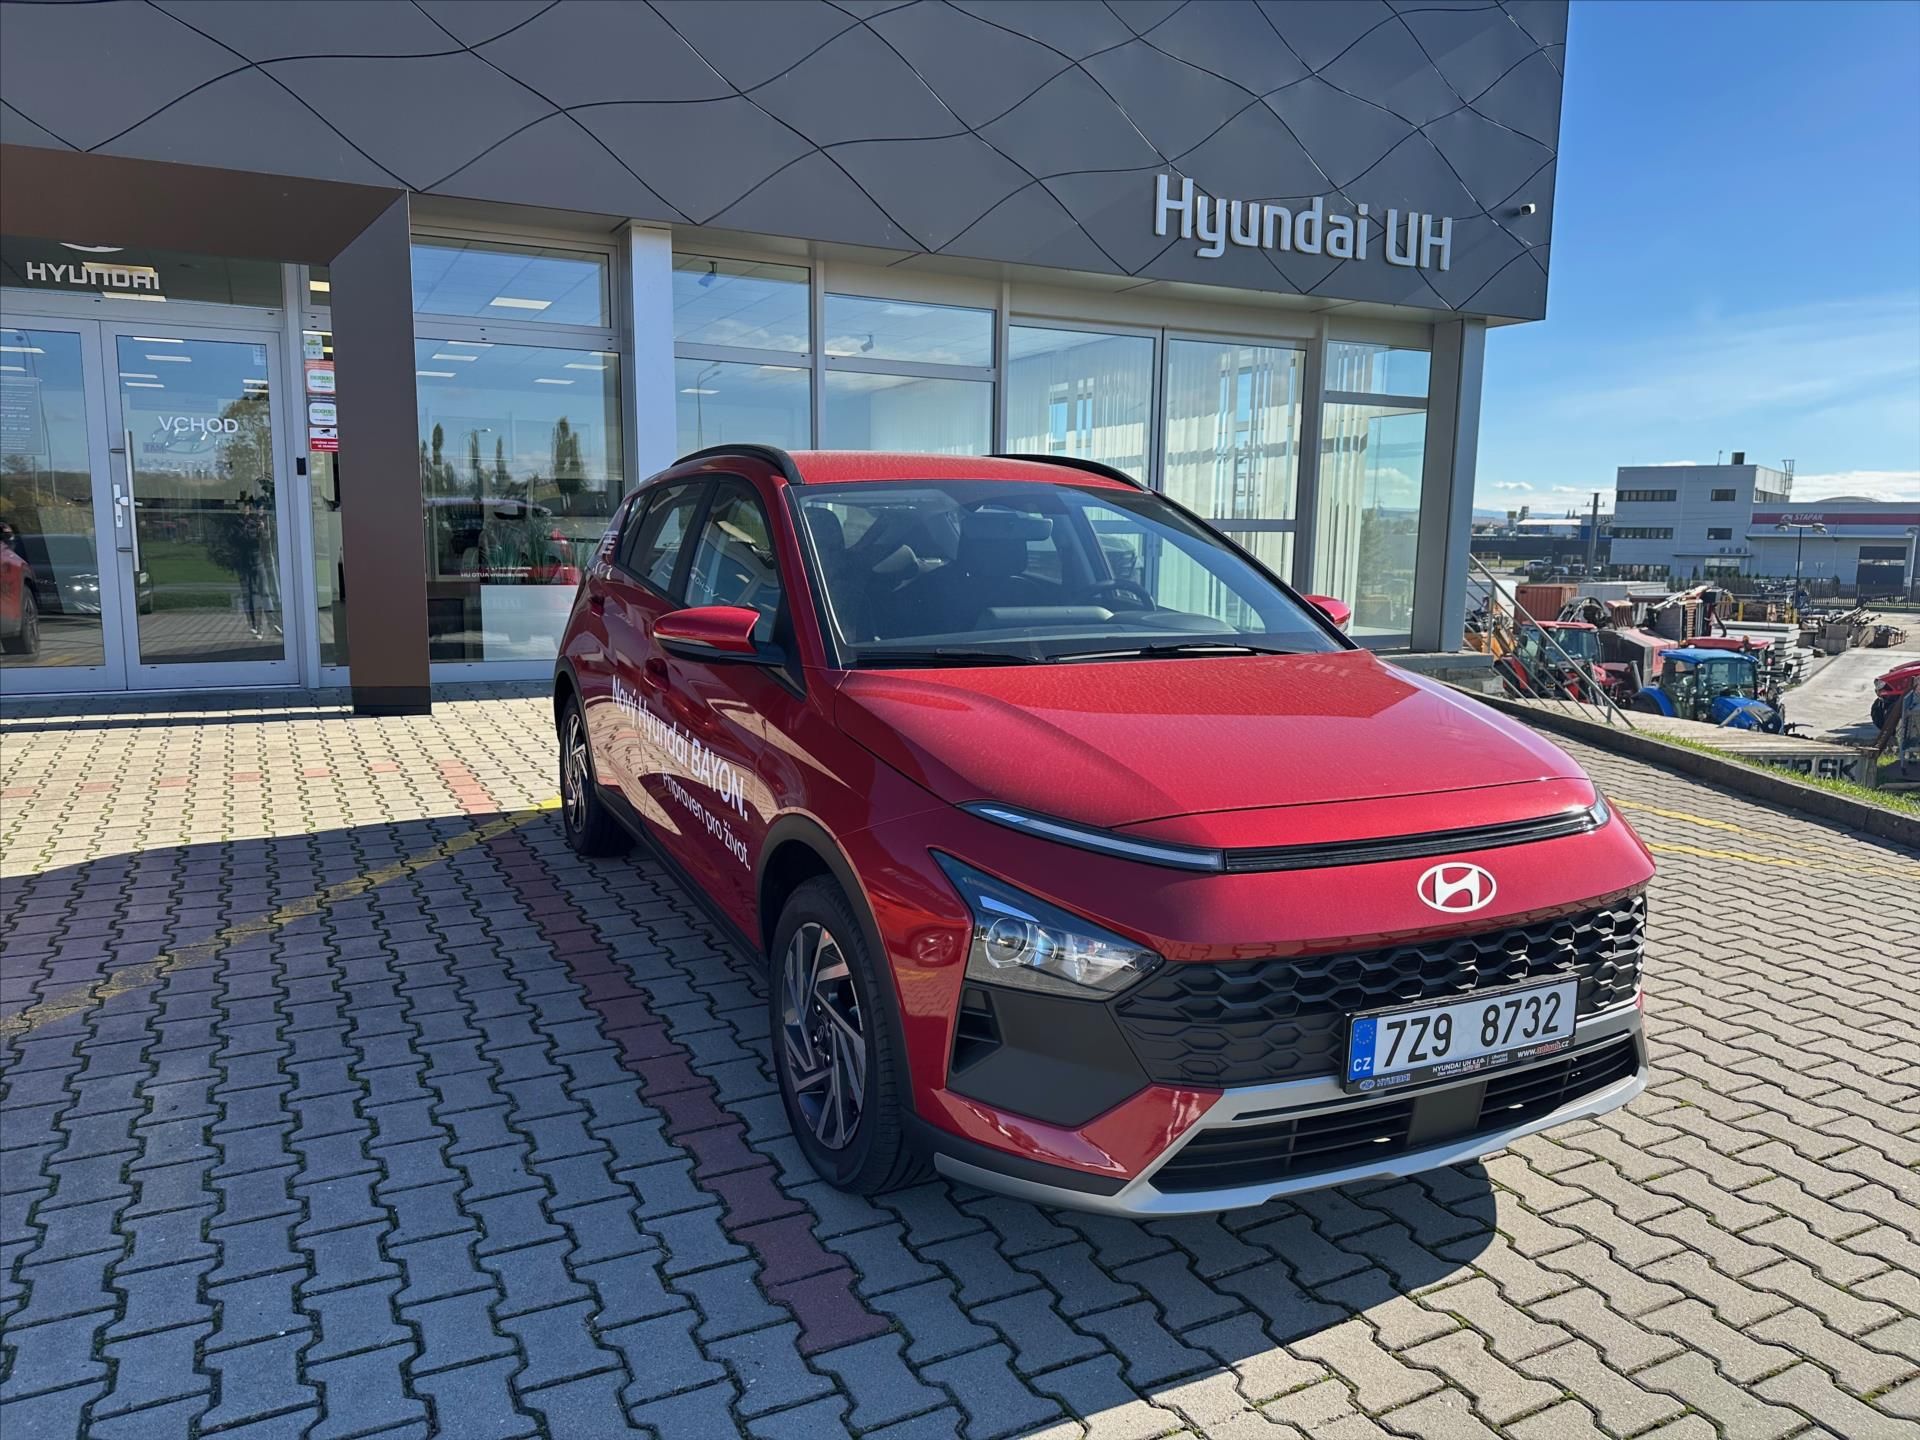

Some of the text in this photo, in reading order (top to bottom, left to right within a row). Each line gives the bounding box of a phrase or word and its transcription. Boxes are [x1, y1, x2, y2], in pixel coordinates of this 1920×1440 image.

[1155, 173, 1453, 272] Hyundai UH
[26, 261, 160, 290] HYUNDAI
[158, 415, 239, 433] VCHOD
[612, 674, 749, 822] Nový Hyundai BAYON.
[704, 811, 723, 840] pro
[723, 819, 751, 871] život.
[1383, 991, 1562, 1067] 7Z9 8732
[1353, 1056, 1372, 1072] CZ
